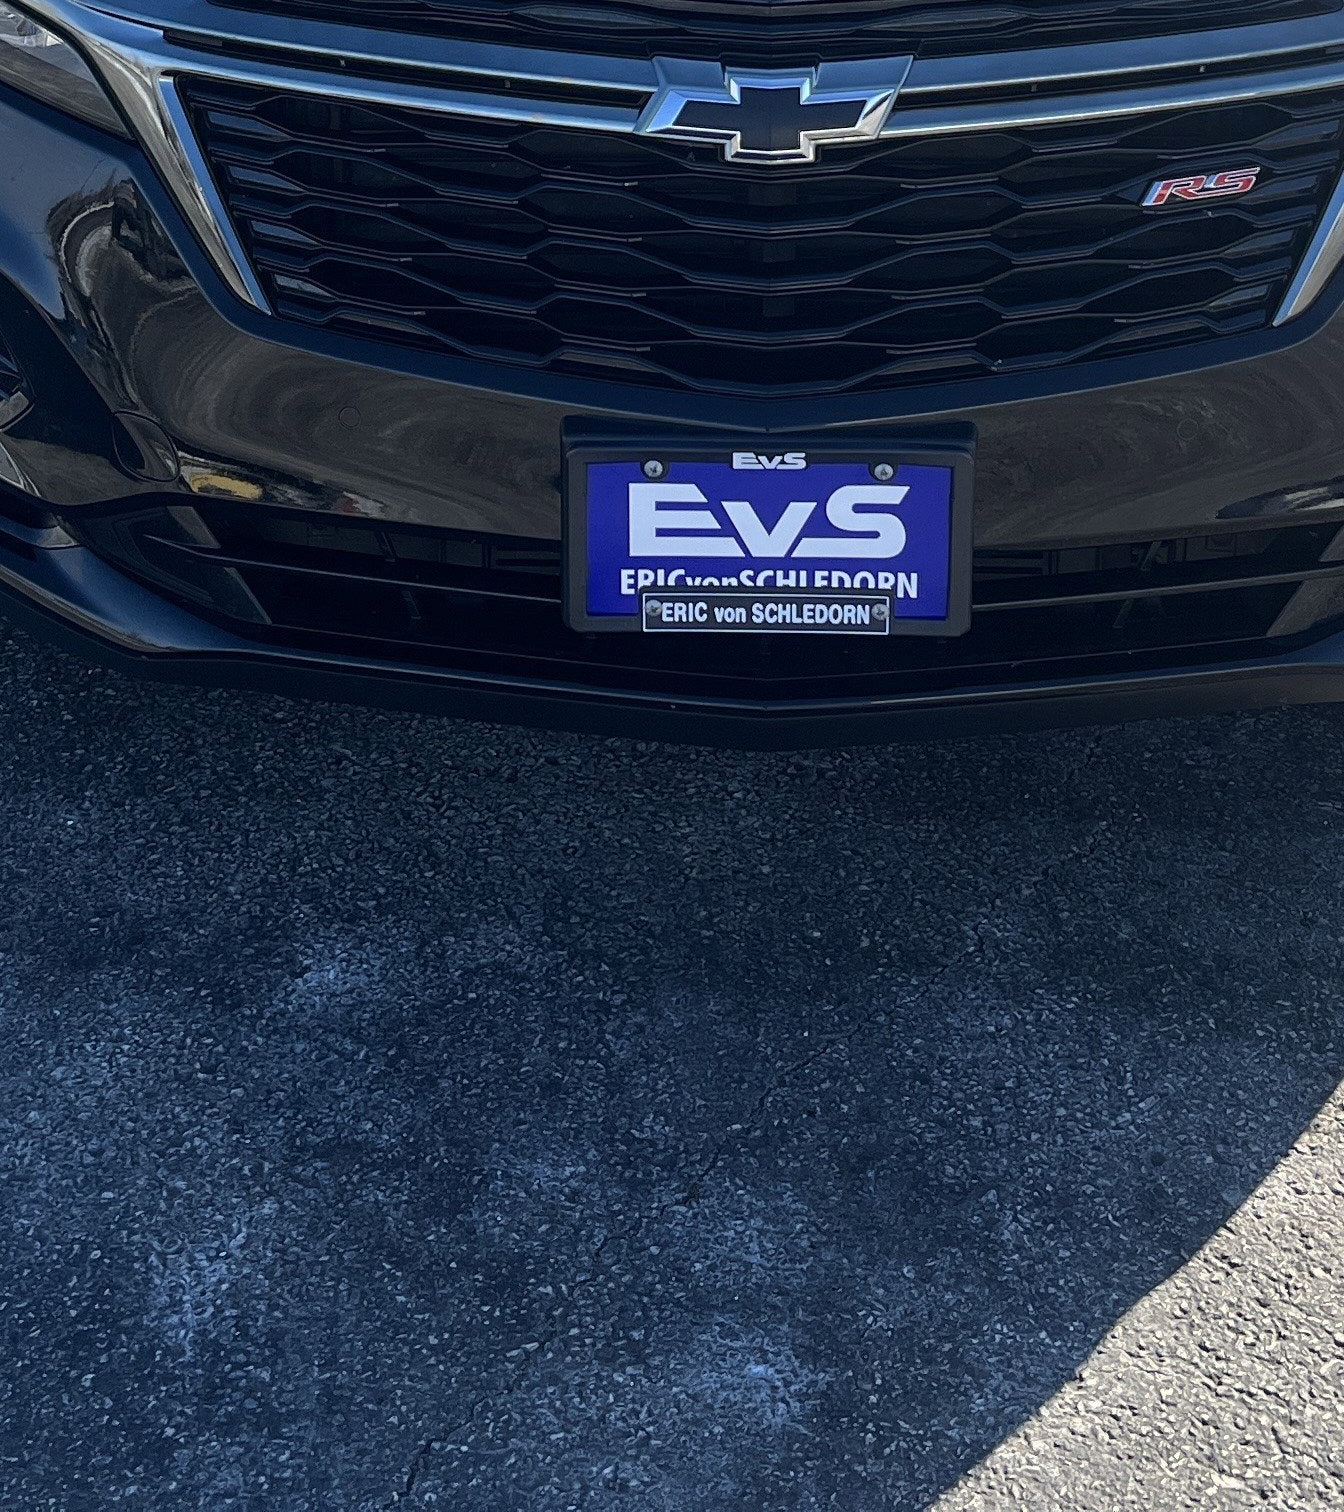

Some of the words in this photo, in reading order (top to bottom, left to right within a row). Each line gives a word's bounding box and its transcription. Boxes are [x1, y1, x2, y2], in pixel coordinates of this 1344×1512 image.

[1142, 167, 1261, 206] RS
[661, 601, 708, 623] ERIC
[714, 605, 747, 624] von
[752, 602, 870, 625] SCHLEDORN
